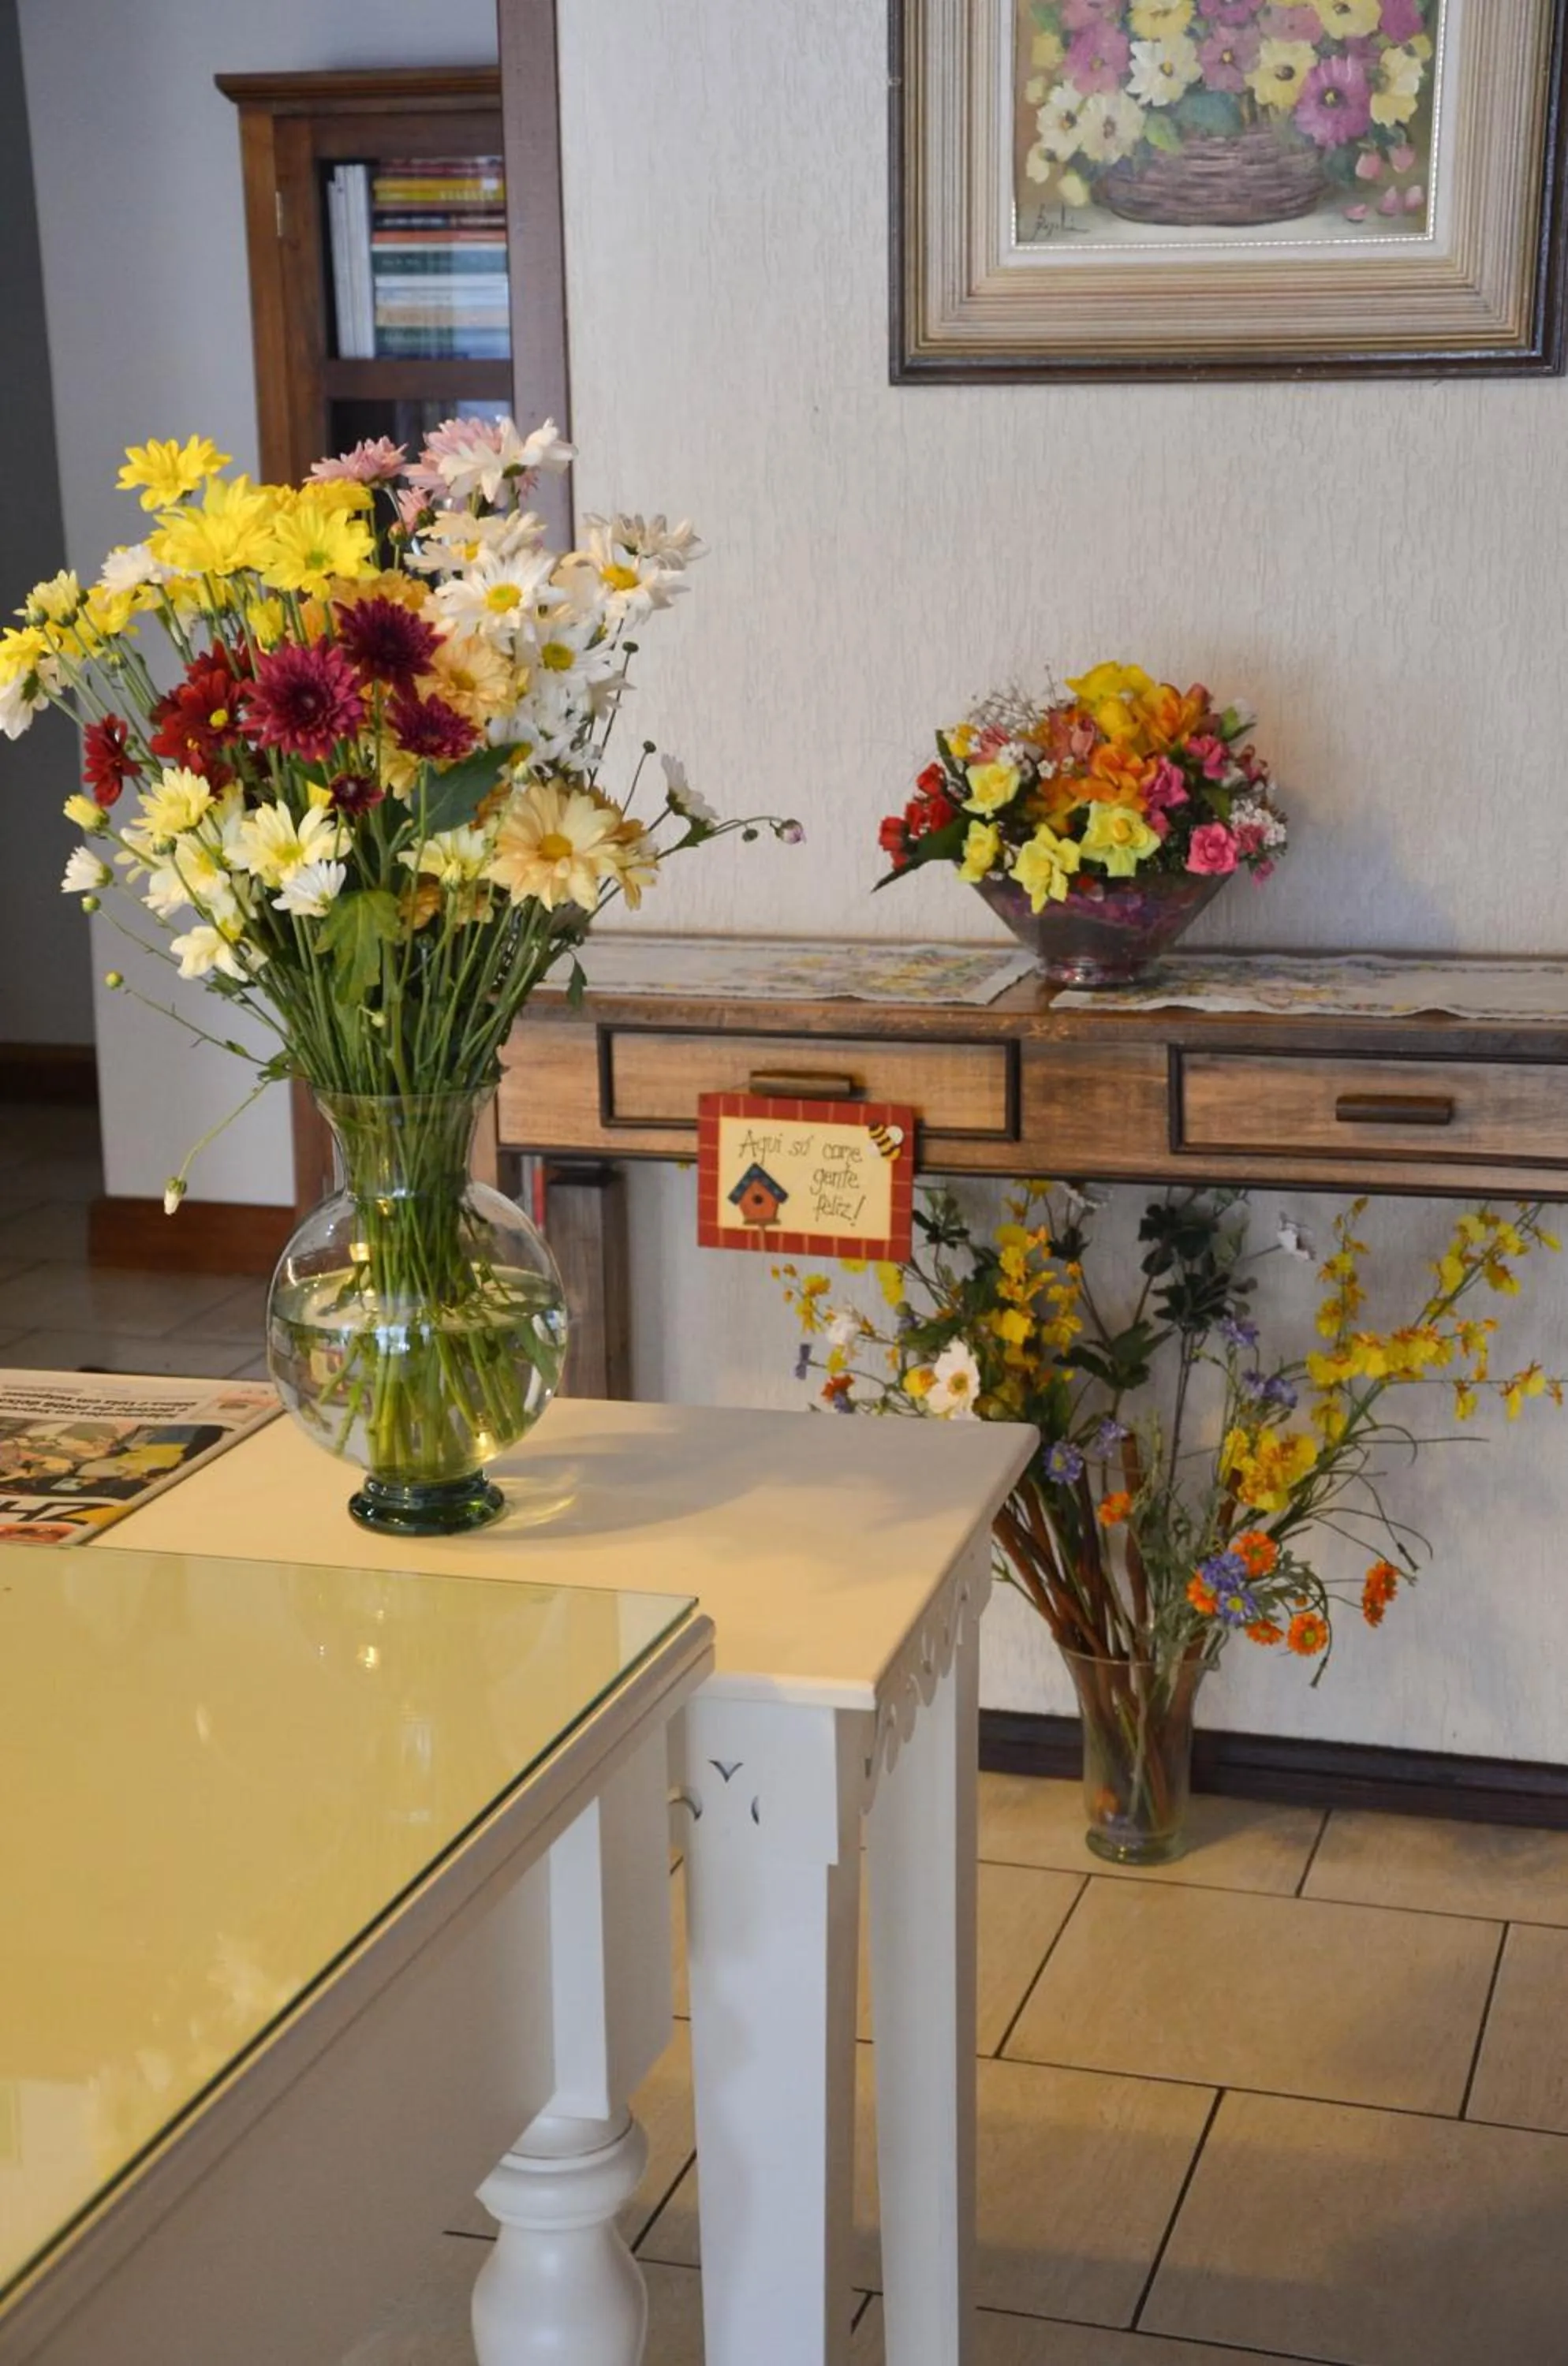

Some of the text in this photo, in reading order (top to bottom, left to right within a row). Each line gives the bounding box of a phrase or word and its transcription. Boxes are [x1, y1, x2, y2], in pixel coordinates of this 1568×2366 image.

[738, 1129, 783, 1165] Aqui
[822, 1142, 863, 1162] come
[809, 1159, 860, 1196] gente
[812, 1193, 867, 1227] feliz!
